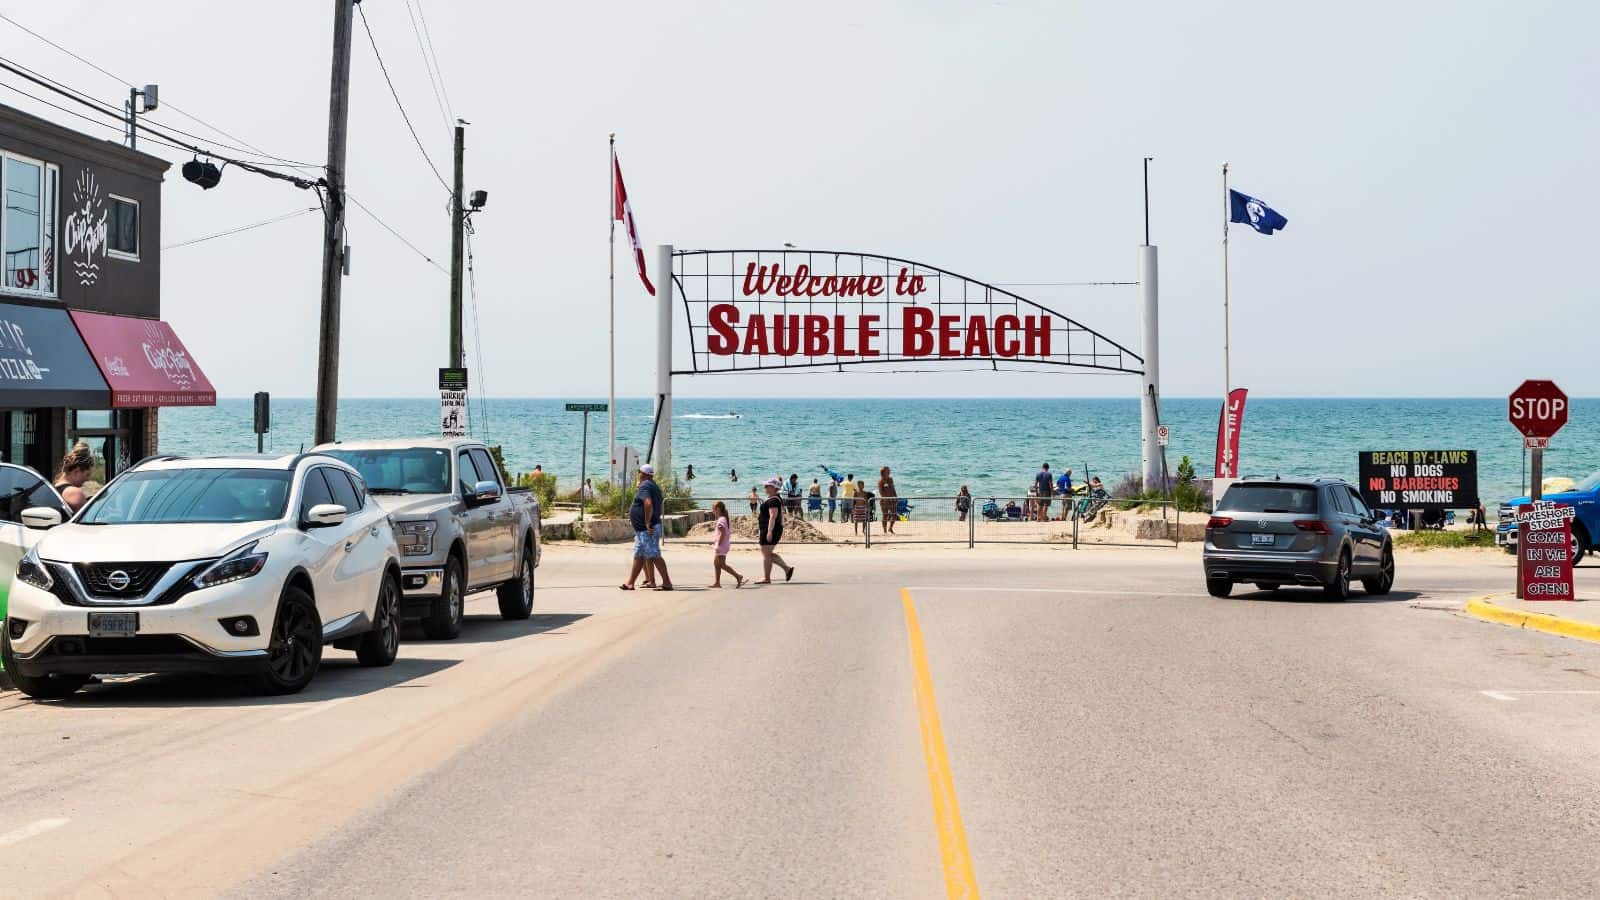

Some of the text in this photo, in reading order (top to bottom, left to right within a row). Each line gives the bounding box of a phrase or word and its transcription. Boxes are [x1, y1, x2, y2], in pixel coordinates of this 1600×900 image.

[742, 262, 927, 297] Welcome to
[707, 303, 1051, 357] SAUBLE BEACH
[0, 358, 34, 380] IZZA
[1512, 397, 1565, 420] STOP
[1372, 451, 1468, 465] BEACH BY-LAWS
[1390, 465, 1444, 477] NO DOGS
[1370, 477, 1459, 490] NO BARBECUES
[1380, 491, 1453, 503] NO SMOKING
[1534, 501, 1553, 511] THE
[1516, 507, 1574, 522] LAKESHORE
[1530, 518, 1563, 530] STORE
[1527, 532, 1566, 544] COME
[1527, 548, 1567, 561] IN WE
[1535, 565, 1561, 577] ARE
[1527, 583, 1569, 595] OPEN!
